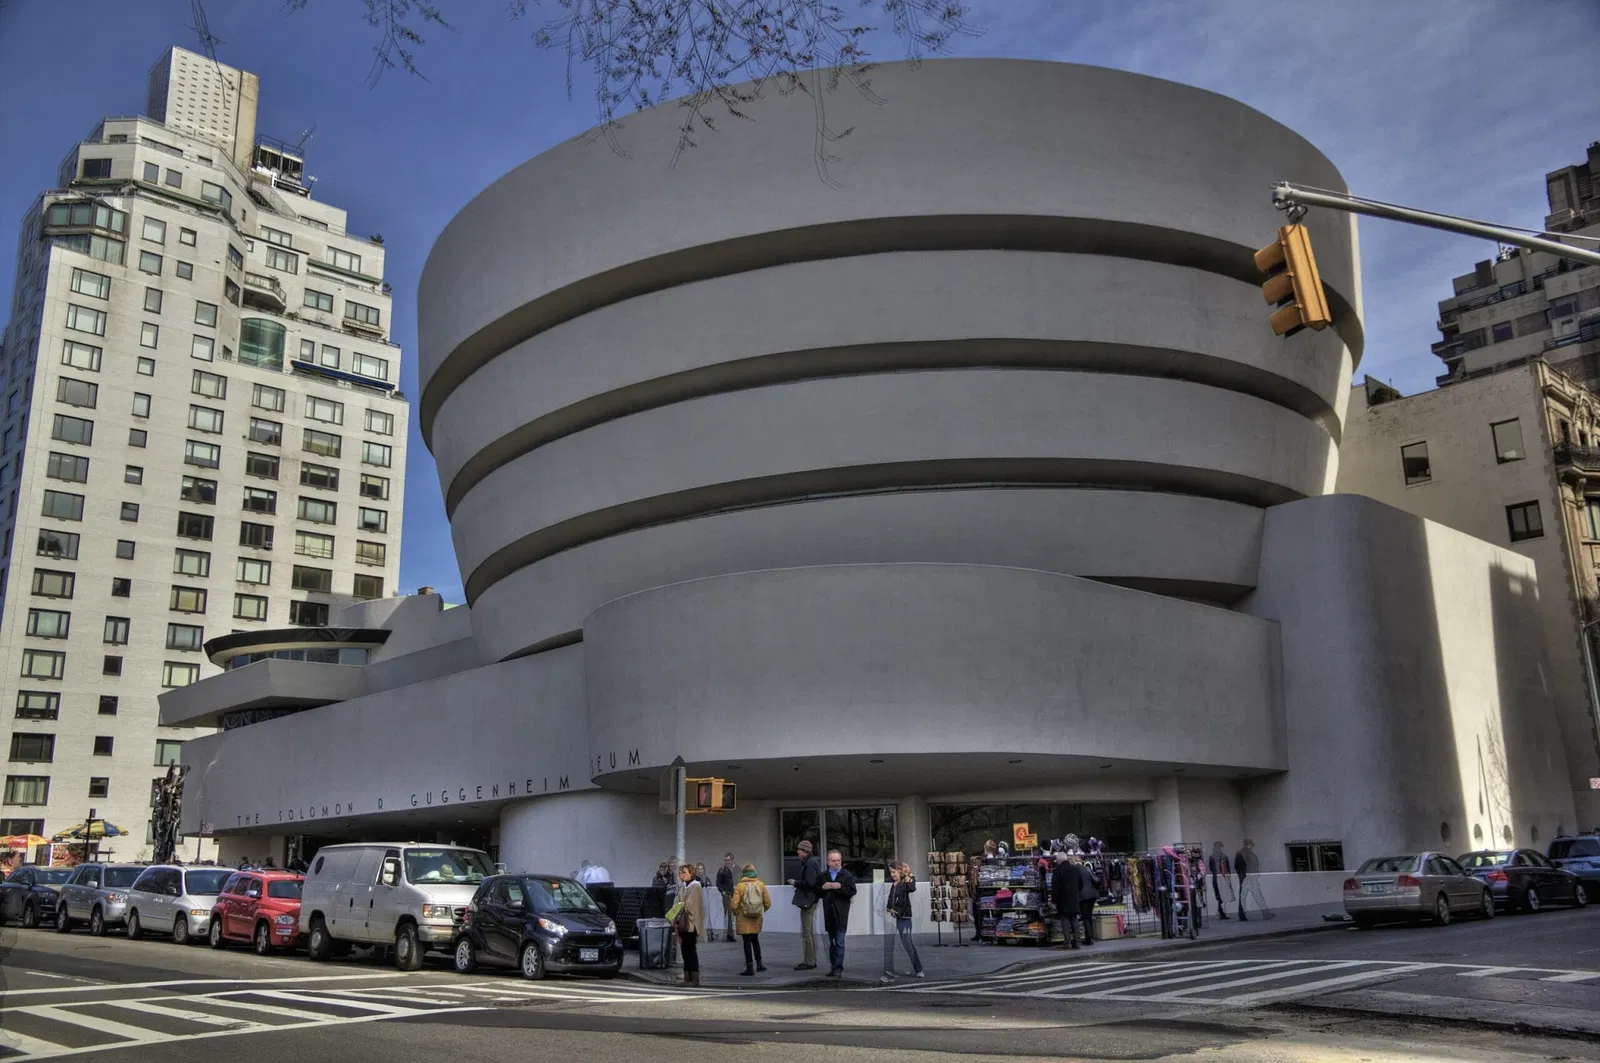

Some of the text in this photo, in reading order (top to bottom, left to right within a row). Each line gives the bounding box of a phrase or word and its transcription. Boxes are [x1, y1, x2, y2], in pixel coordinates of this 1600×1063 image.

[237, 814, 259, 825] THE
[279, 802, 353, 821] SOLOMON
[378, 799, 383, 810] R
[410, 776, 569, 806] GUGGENHEIM
